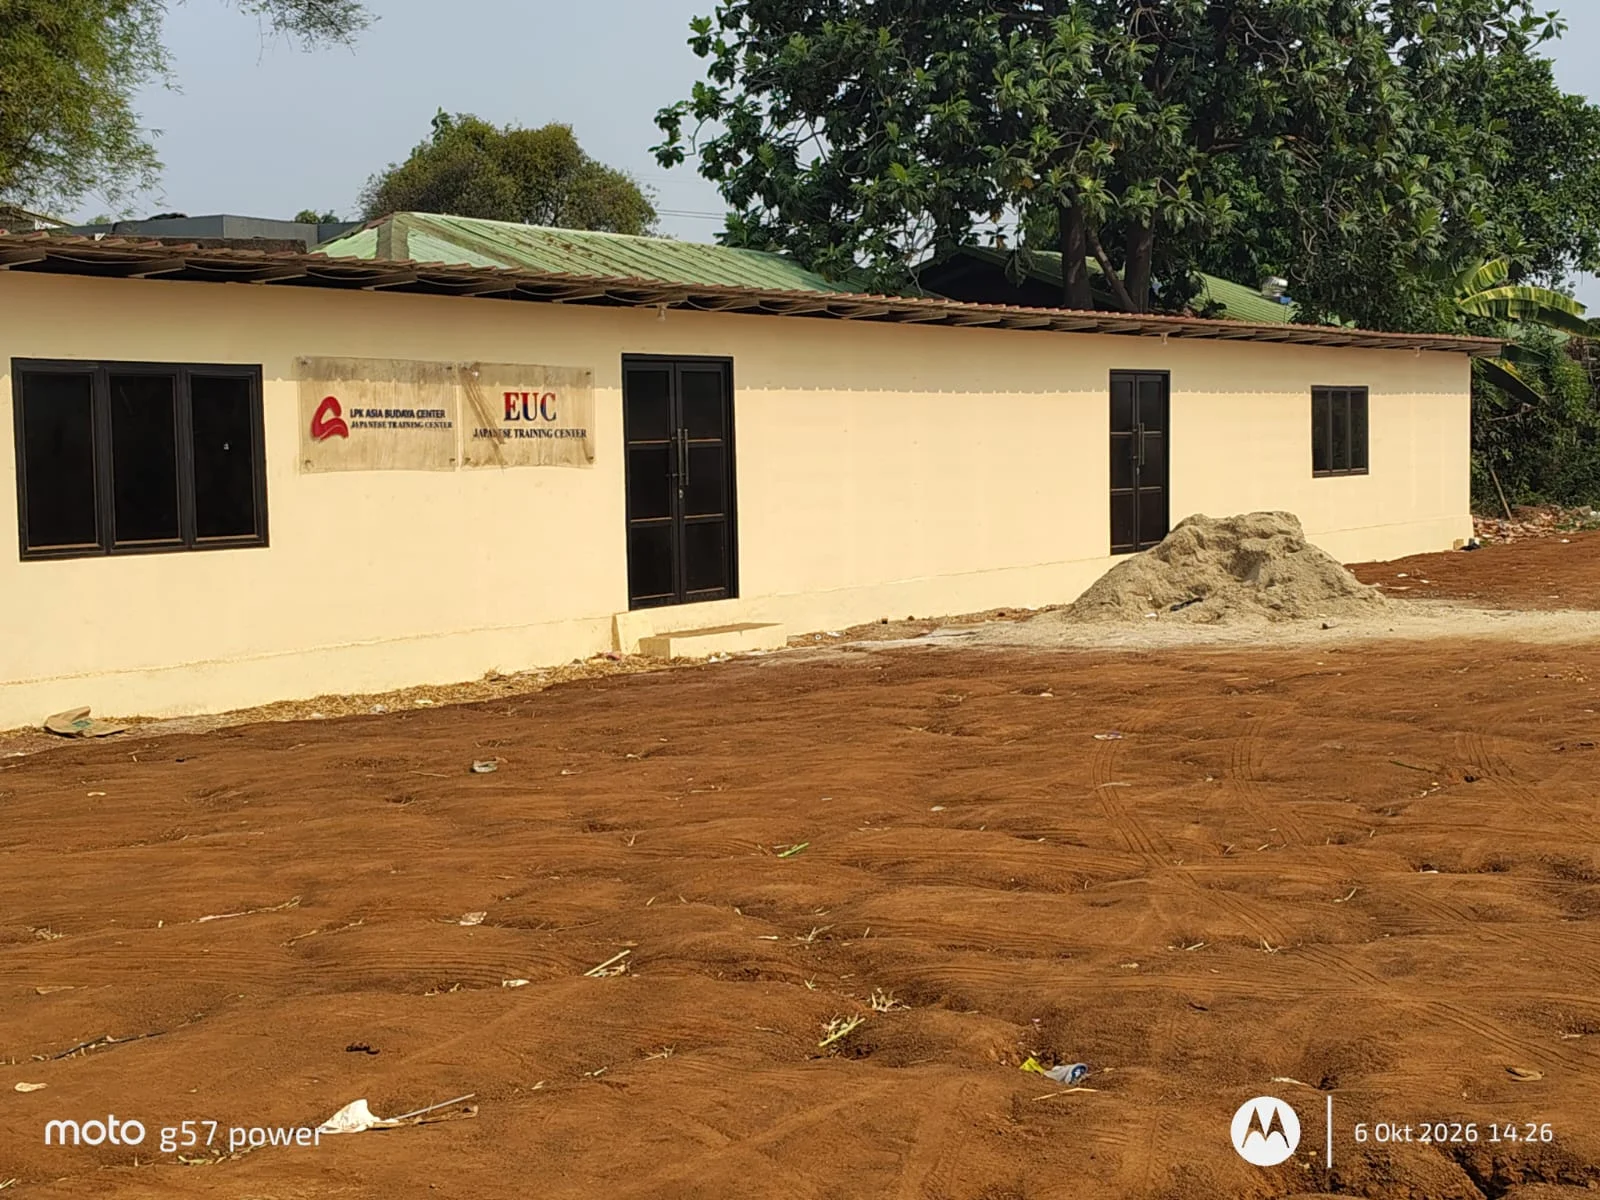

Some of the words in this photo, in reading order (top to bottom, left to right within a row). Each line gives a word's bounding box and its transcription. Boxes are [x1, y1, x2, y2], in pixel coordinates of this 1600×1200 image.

[503, 391, 557, 422] EUC
[349, 409, 363, 418] LPK
[365, 409, 383, 419] ASIA
[384, 409, 415, 419] BUDAYA
[416, 410, 445, 419] CENTER
[350, 421, 387, 429] JAPANESE
[388, 421, 424, 429] TRAINING
[425, 421, 453, 429] CENTER
[514, 428, 553, 438] TRAINING
[554, 428, 587, 438] CENTER
